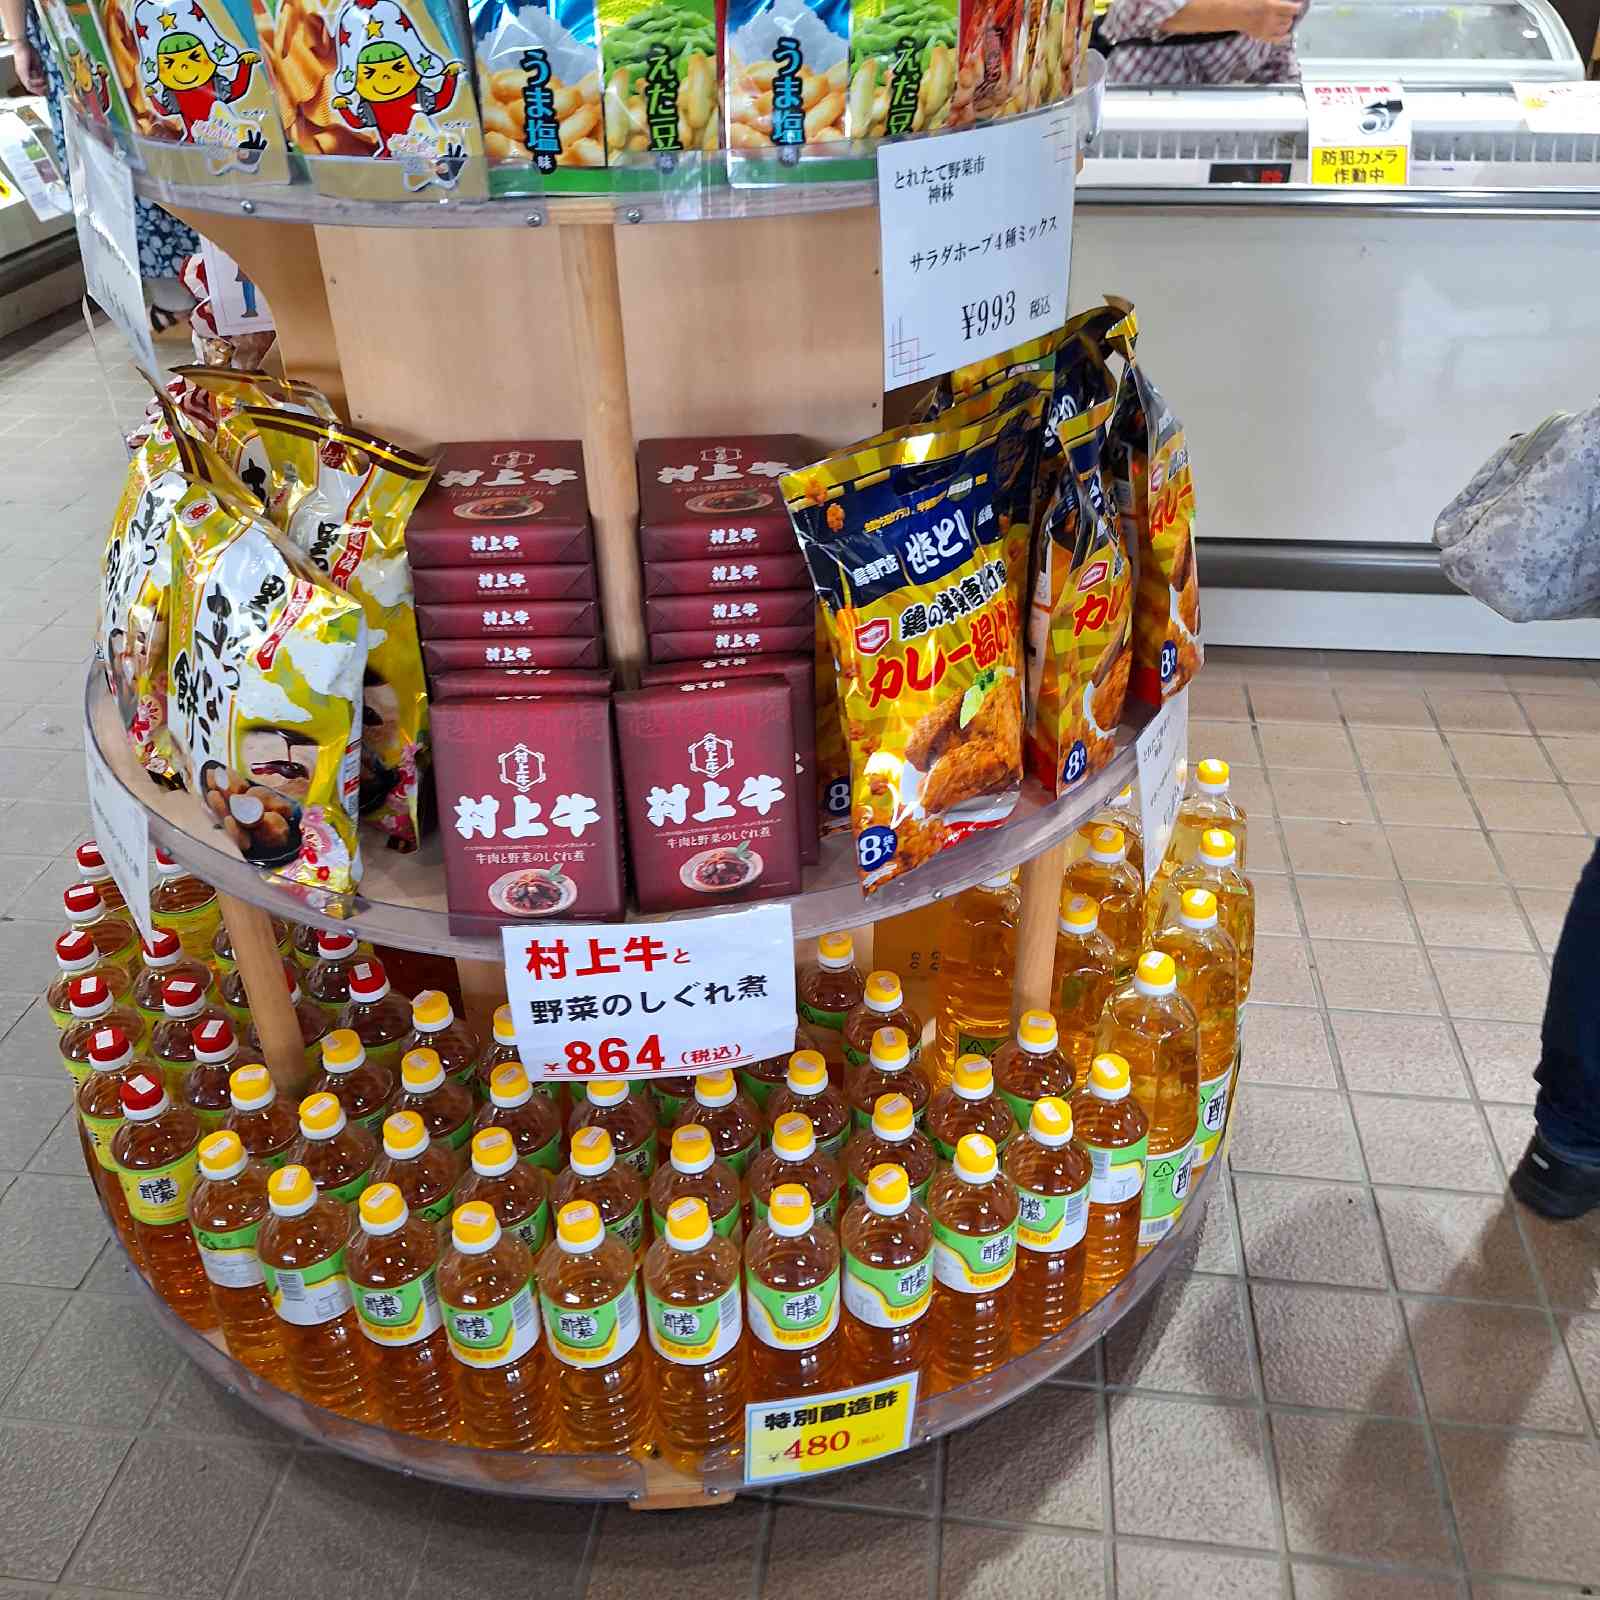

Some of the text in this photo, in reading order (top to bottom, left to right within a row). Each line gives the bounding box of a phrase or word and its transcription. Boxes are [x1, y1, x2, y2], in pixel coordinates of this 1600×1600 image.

[1321, 150, 1398, 166] 防犯カメラ
[894, 154, 985, 190] とれたて野菜市
[1334, 168, 1384, 183] 作動中
[438, 468, 578, 487] 村上牛
[657, 461, 790, 483] 村上牛
[471, 535, 520, 552] 村上牛
[709, 528, 758, 545] 村上牛
[479, 573, 527, 589] 村上牛
[711, 565, 759, 581] 村上牛
[483, 610, 531, 626] 村上牛
[712, 602, 759, 619] 村上牛
[715, 633, 761, 649] 村上牛
[485, 647, 533, 663] 村上牛
[646, 774, 786, 827] 村上牛
[453, 792, 601, 840] 村上牛
[666, 828, 773, 849] 牛肉と野菜のしぐれ煮
[475, 849, 585, 866] 牛肉と野菜のしぐれ煮
[525, 936, 692, 981] 村上牛と
[530, 974, 769, 1025] 野菜のしぐれ煮
